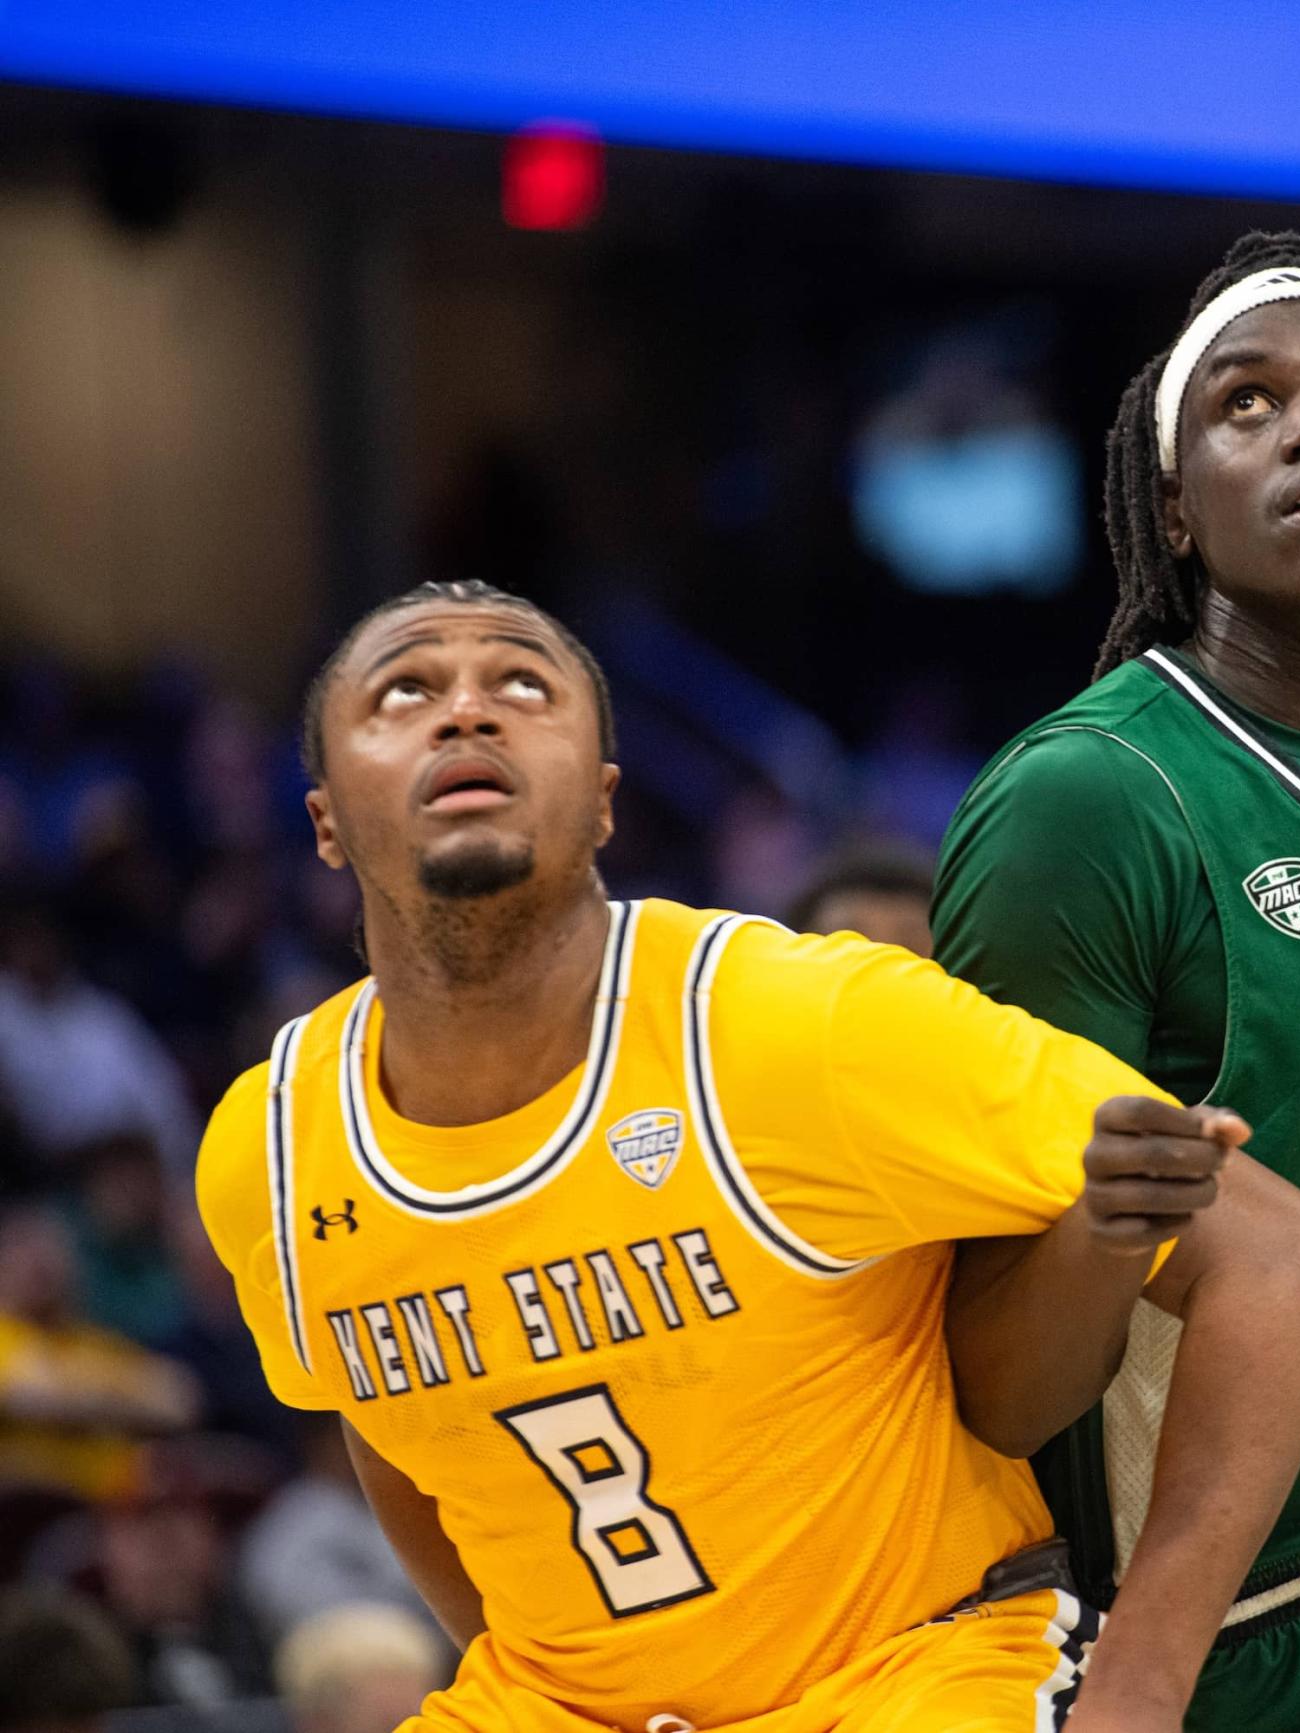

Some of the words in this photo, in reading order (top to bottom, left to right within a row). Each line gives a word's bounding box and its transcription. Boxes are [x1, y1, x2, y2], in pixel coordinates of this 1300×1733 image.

[326, 1284, 486, 1401] KENT
[503, 1228, 741, 1362] STATE
[492, 1382, 718, 1619] 8
